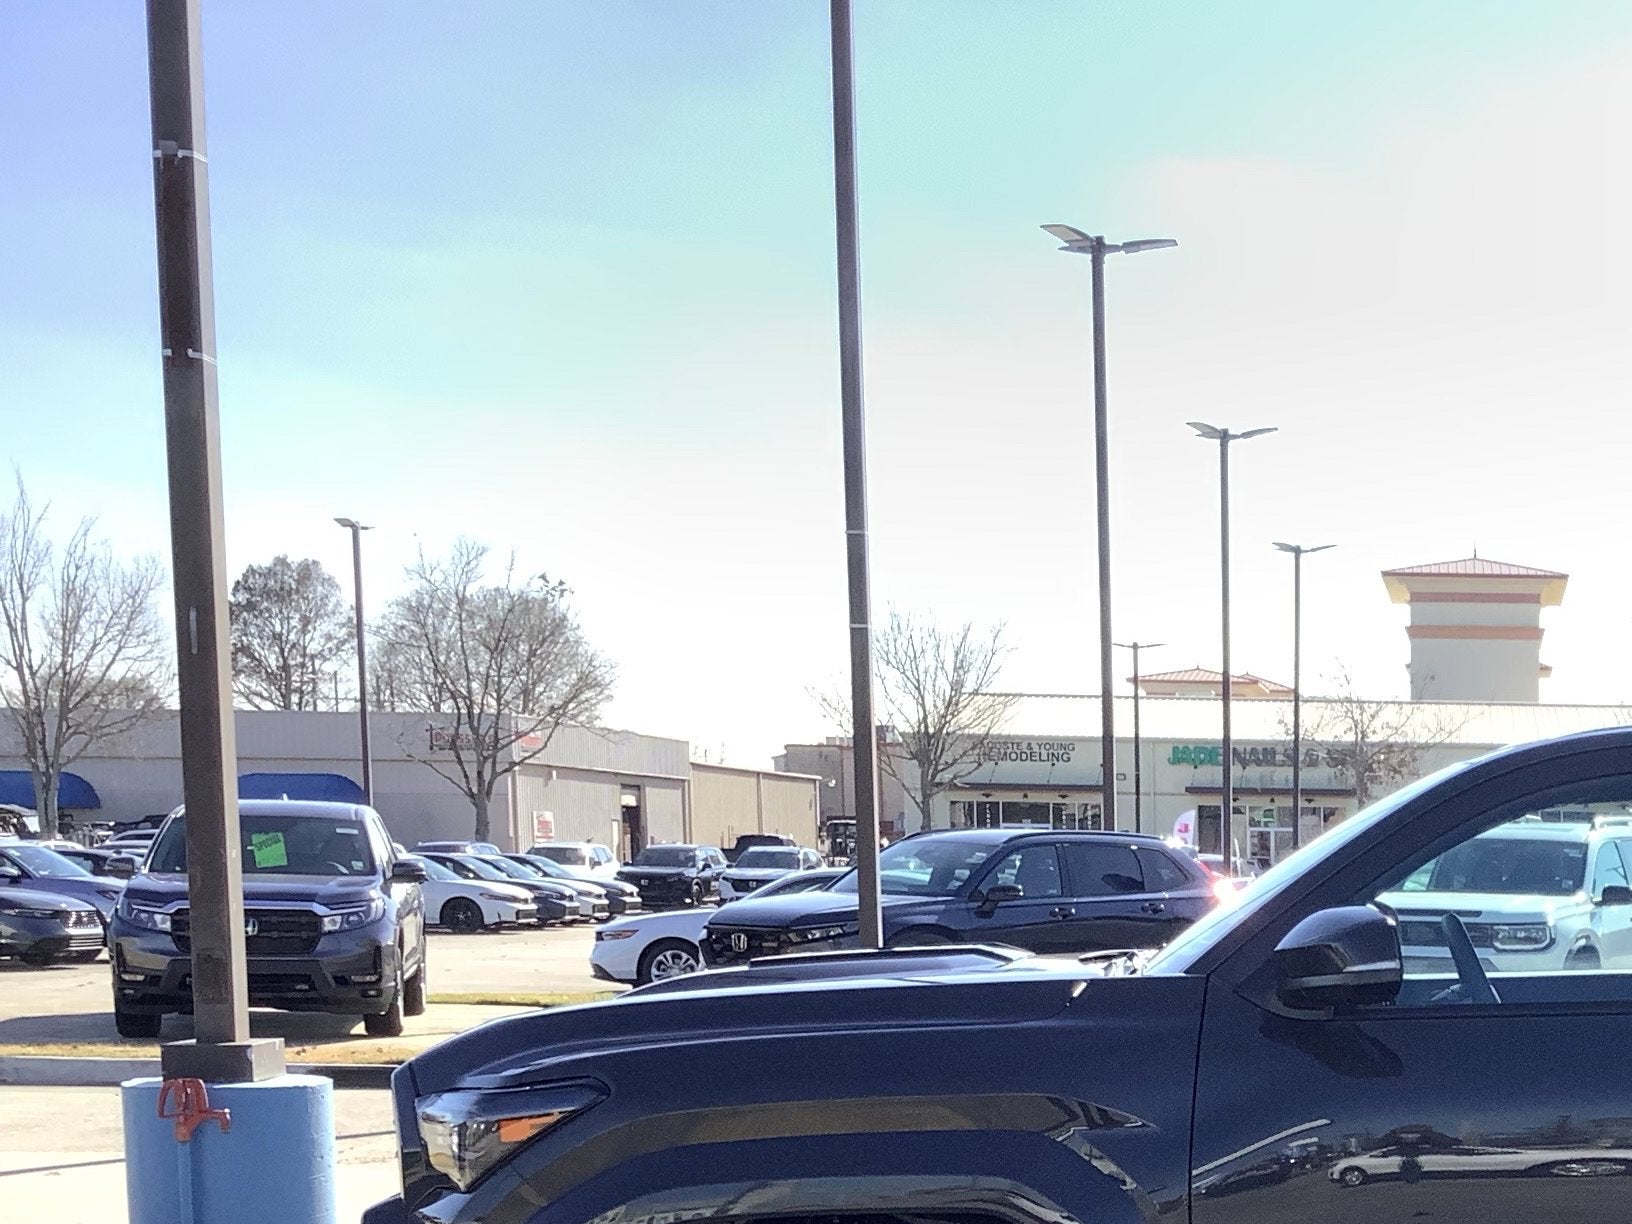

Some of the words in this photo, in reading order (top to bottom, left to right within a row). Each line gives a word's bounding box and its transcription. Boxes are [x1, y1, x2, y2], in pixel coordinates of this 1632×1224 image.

[1026, 742, 1033, 751] &
[1036, 742, 1076, 752] YOUNG
[1168, 745, 1223, 766] JADE
